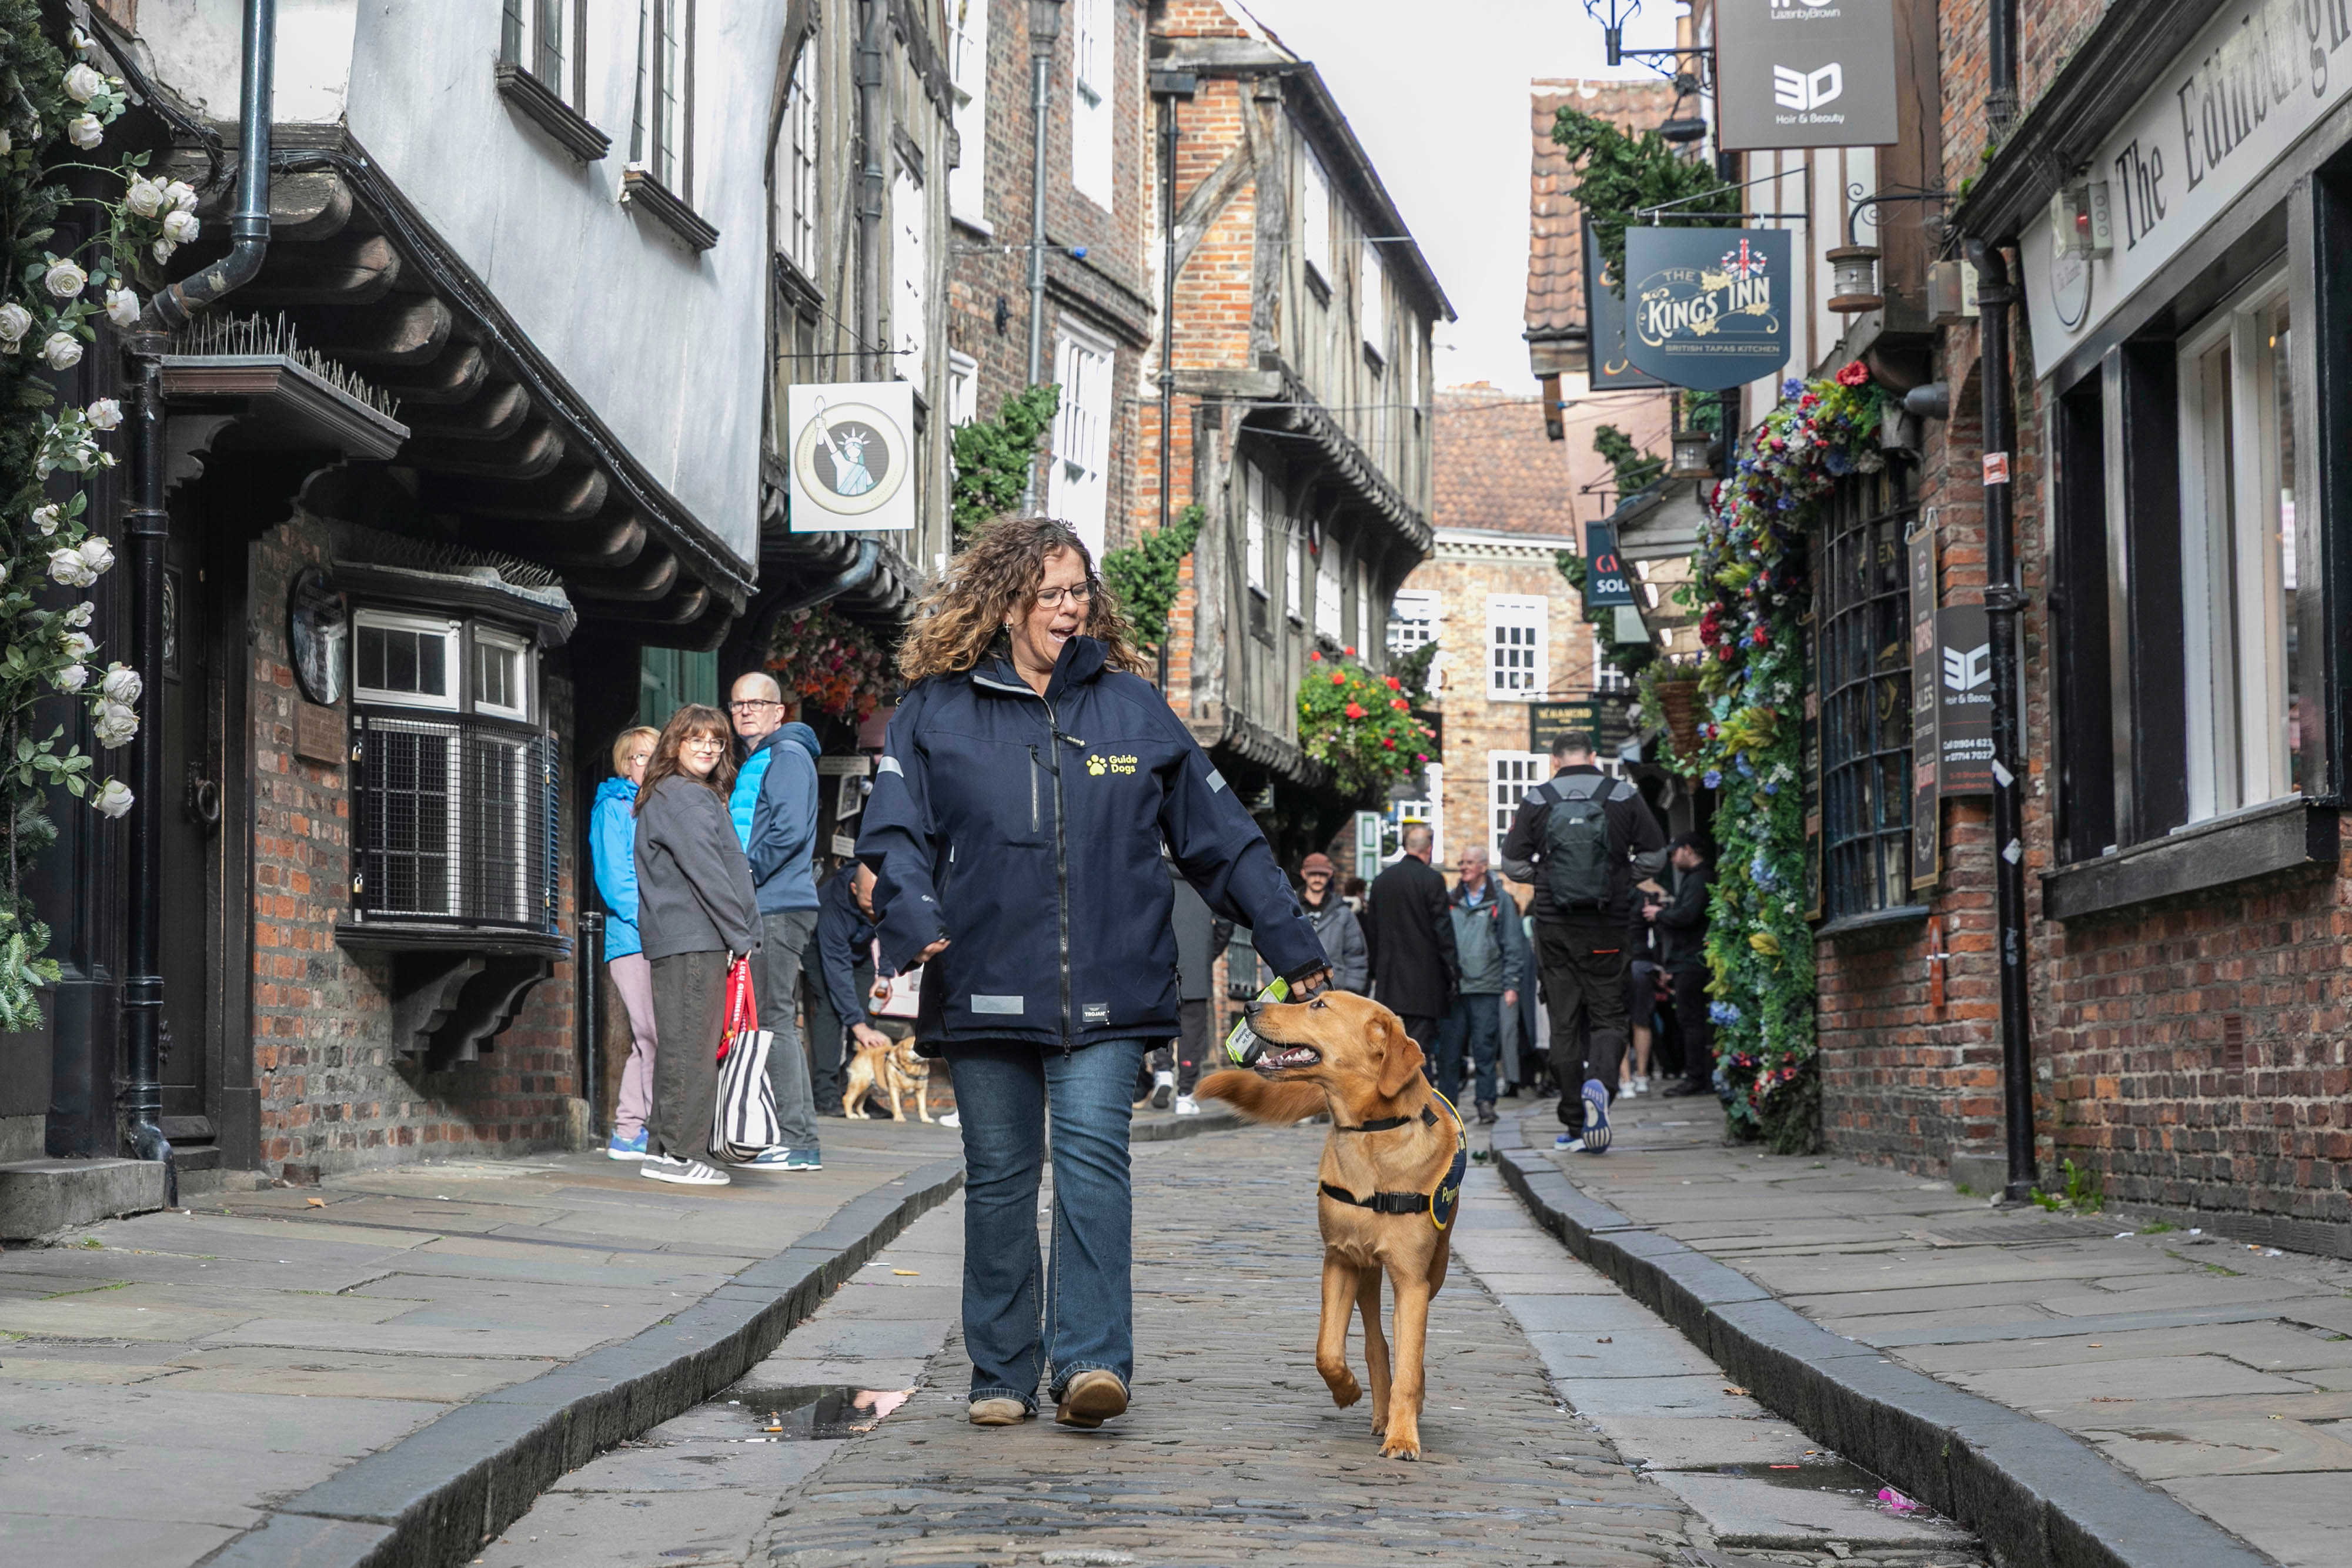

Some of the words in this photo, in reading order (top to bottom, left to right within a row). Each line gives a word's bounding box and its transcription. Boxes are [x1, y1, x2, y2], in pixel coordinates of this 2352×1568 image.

[1773, 62, 1843, 111] 3D
[1776, 114, 1797, 124] Hair
[1798, 113, 1808, 123] &
[1809, 112, 1845, 125] Beauty
[2116, 138, 2167, 252] The
[1663, 270, 1696, 282] THE
[1648, 291, 1718, 338] KINGS
[1728, 276, 1770, 311] INN
[1665, 344, 1703, 353] BRITISH
[1705, 344, 1736, 353] TAPAS
[1737, 344, 1780, 353] KITCHEN
[1966, 693, 1992, 704] Beau
[1109, 754, 1138, 764] Guide
[1111, 764, 1136, 775] Dogs
[733, 982, 744, 1022] GUINNESS
